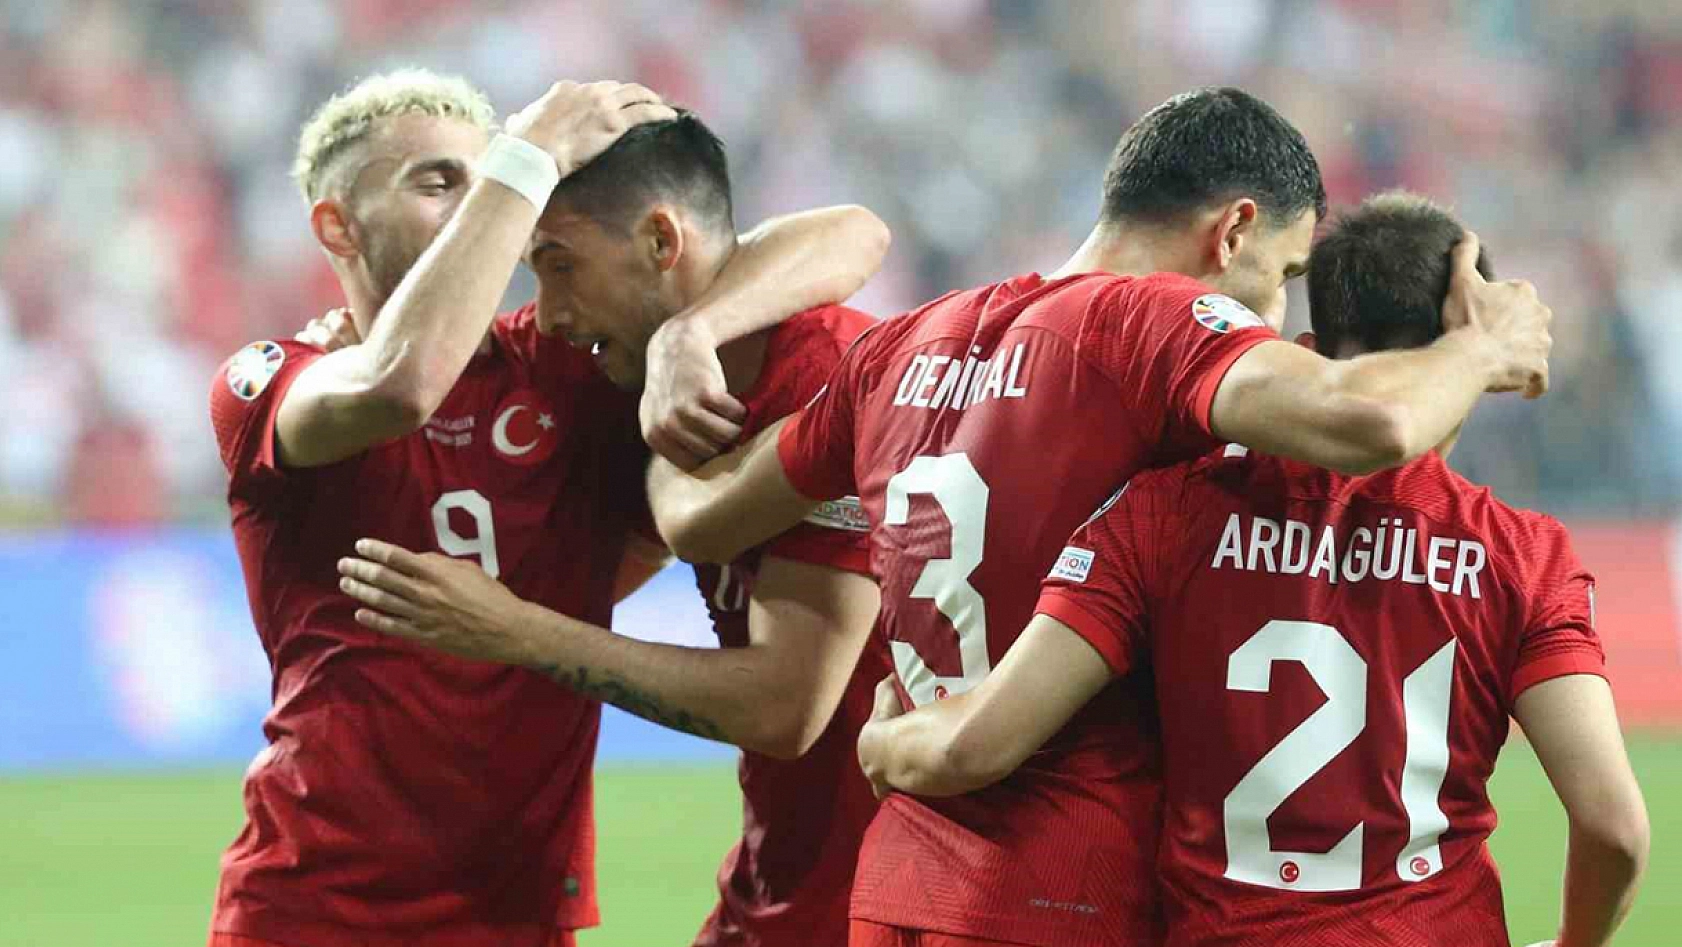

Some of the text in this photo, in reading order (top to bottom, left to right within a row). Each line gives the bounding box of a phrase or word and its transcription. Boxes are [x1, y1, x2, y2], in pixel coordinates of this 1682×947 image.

[431, 490, 499, 580] 9
[885, 454, 990, 706] 3
[1212, 513, 1486, 598] ARDAGÜLER
[1224, 621, 1457, 890] 21
